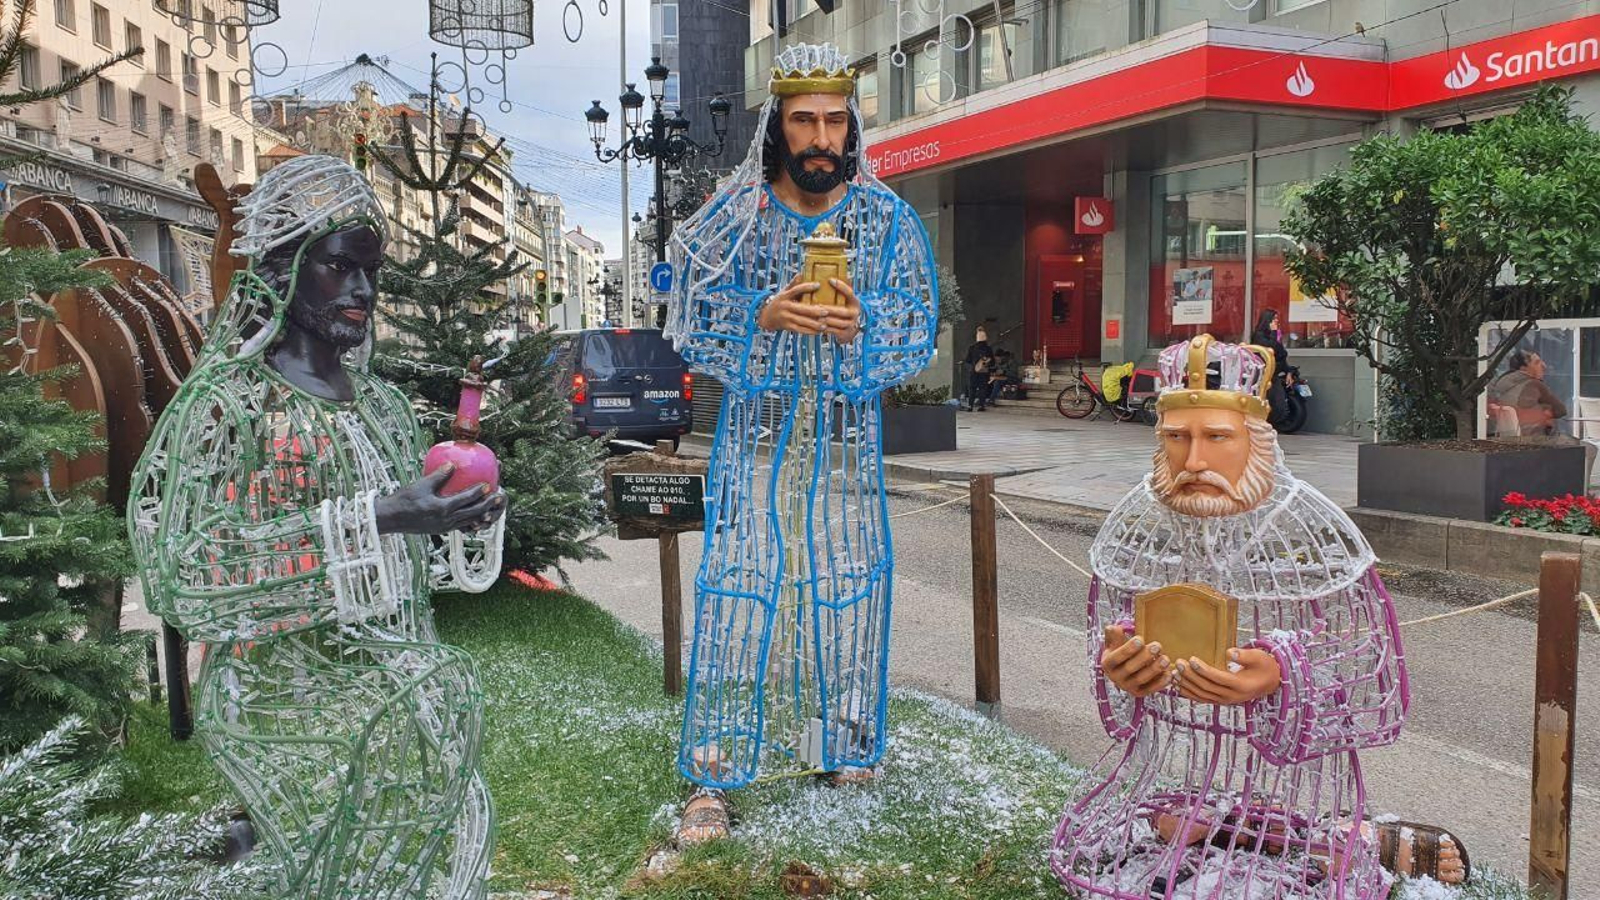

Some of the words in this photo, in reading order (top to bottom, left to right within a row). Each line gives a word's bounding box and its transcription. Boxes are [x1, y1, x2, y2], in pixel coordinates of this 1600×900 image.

[884, 140, 941, 171] Empresas
[18, 161, 73, 193] ABANCA
[117, 187, 160, 215] ABANCA
[190, 206, 220, 229] ABANC
[644, 390, 680, 399] amazon
[625, 476, 634, 484] SE
[669, 477, 691, 485] ALGO
[631, 485, 657, 494] CHAME
[622, 494, 637, 502] POR
[638, 495, 650, 503] UN
[650, 495, 661, 503] BO
